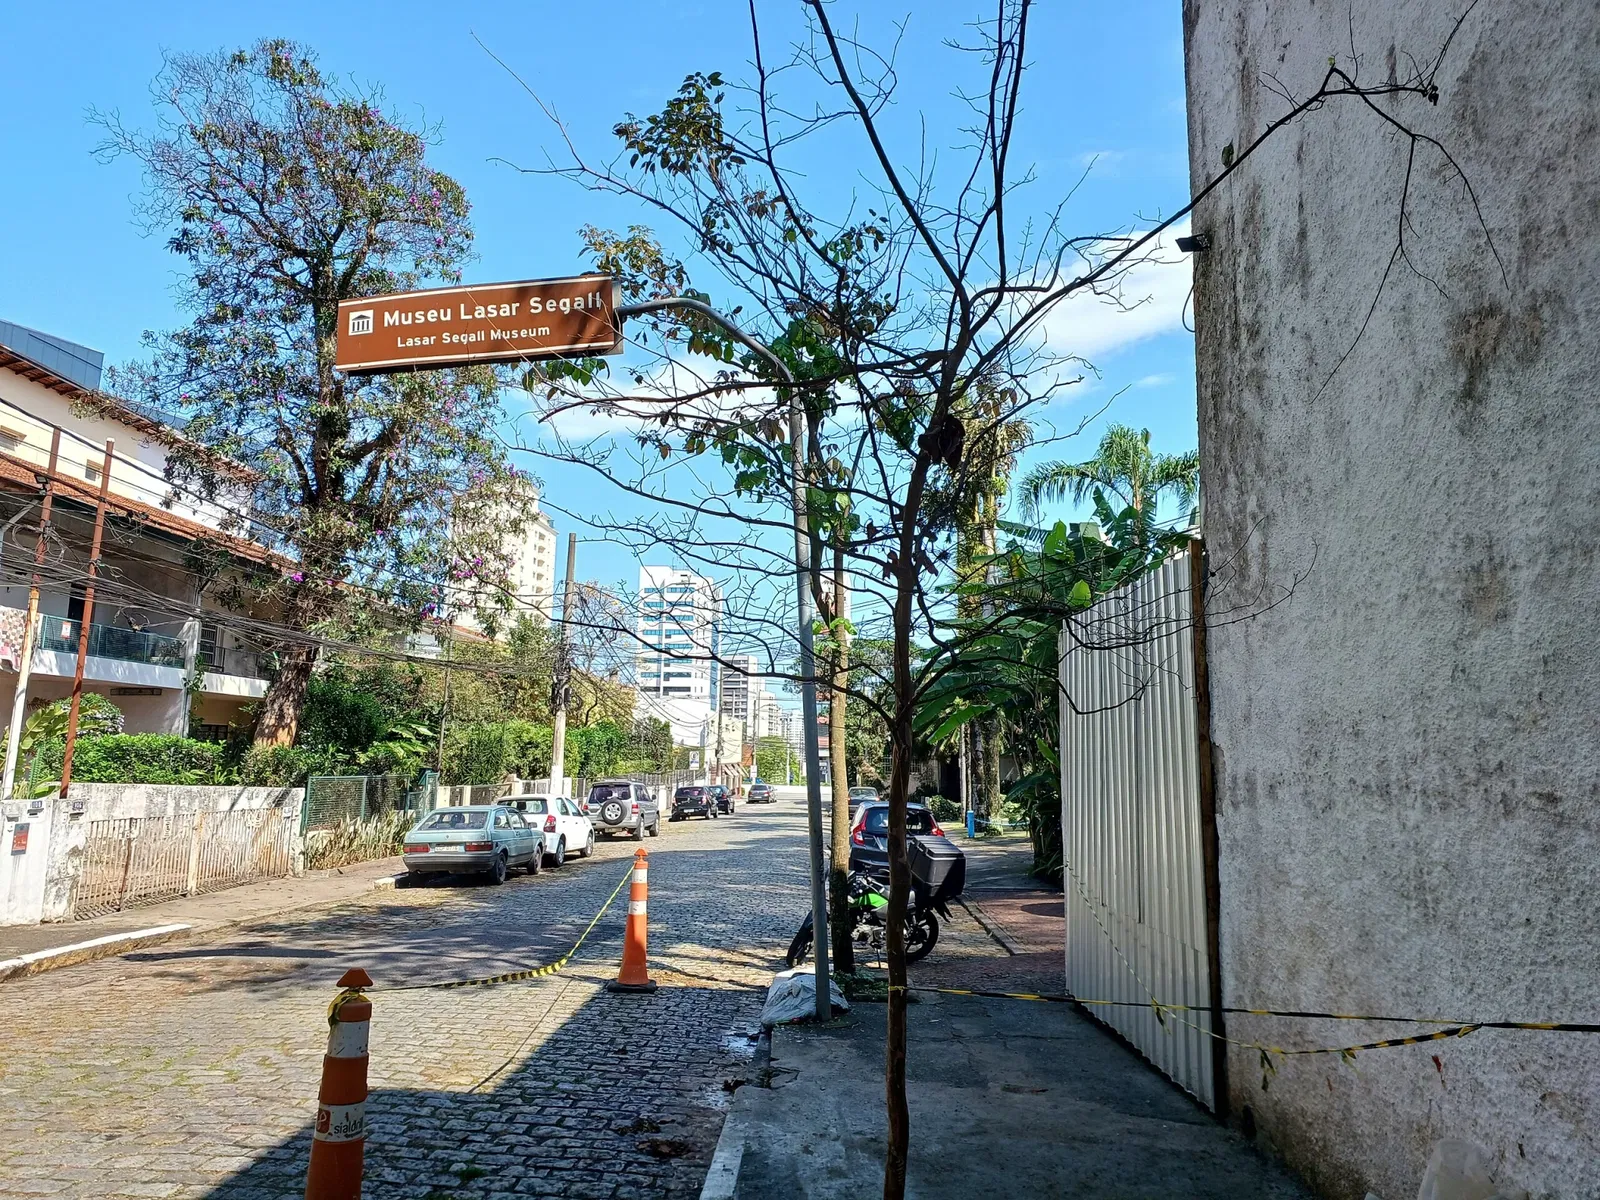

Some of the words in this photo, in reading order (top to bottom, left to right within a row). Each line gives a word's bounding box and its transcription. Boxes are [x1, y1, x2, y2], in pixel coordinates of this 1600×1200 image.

[384, 304, 452, 327] Museu
[460, 300, 520, 320] Lasar
[530, 292, 601, 315] Segall
[397, 335, 436, 348] Lasar
[442, 329, 485, 344] Segall
[490, 325, 550, 341] Museum
